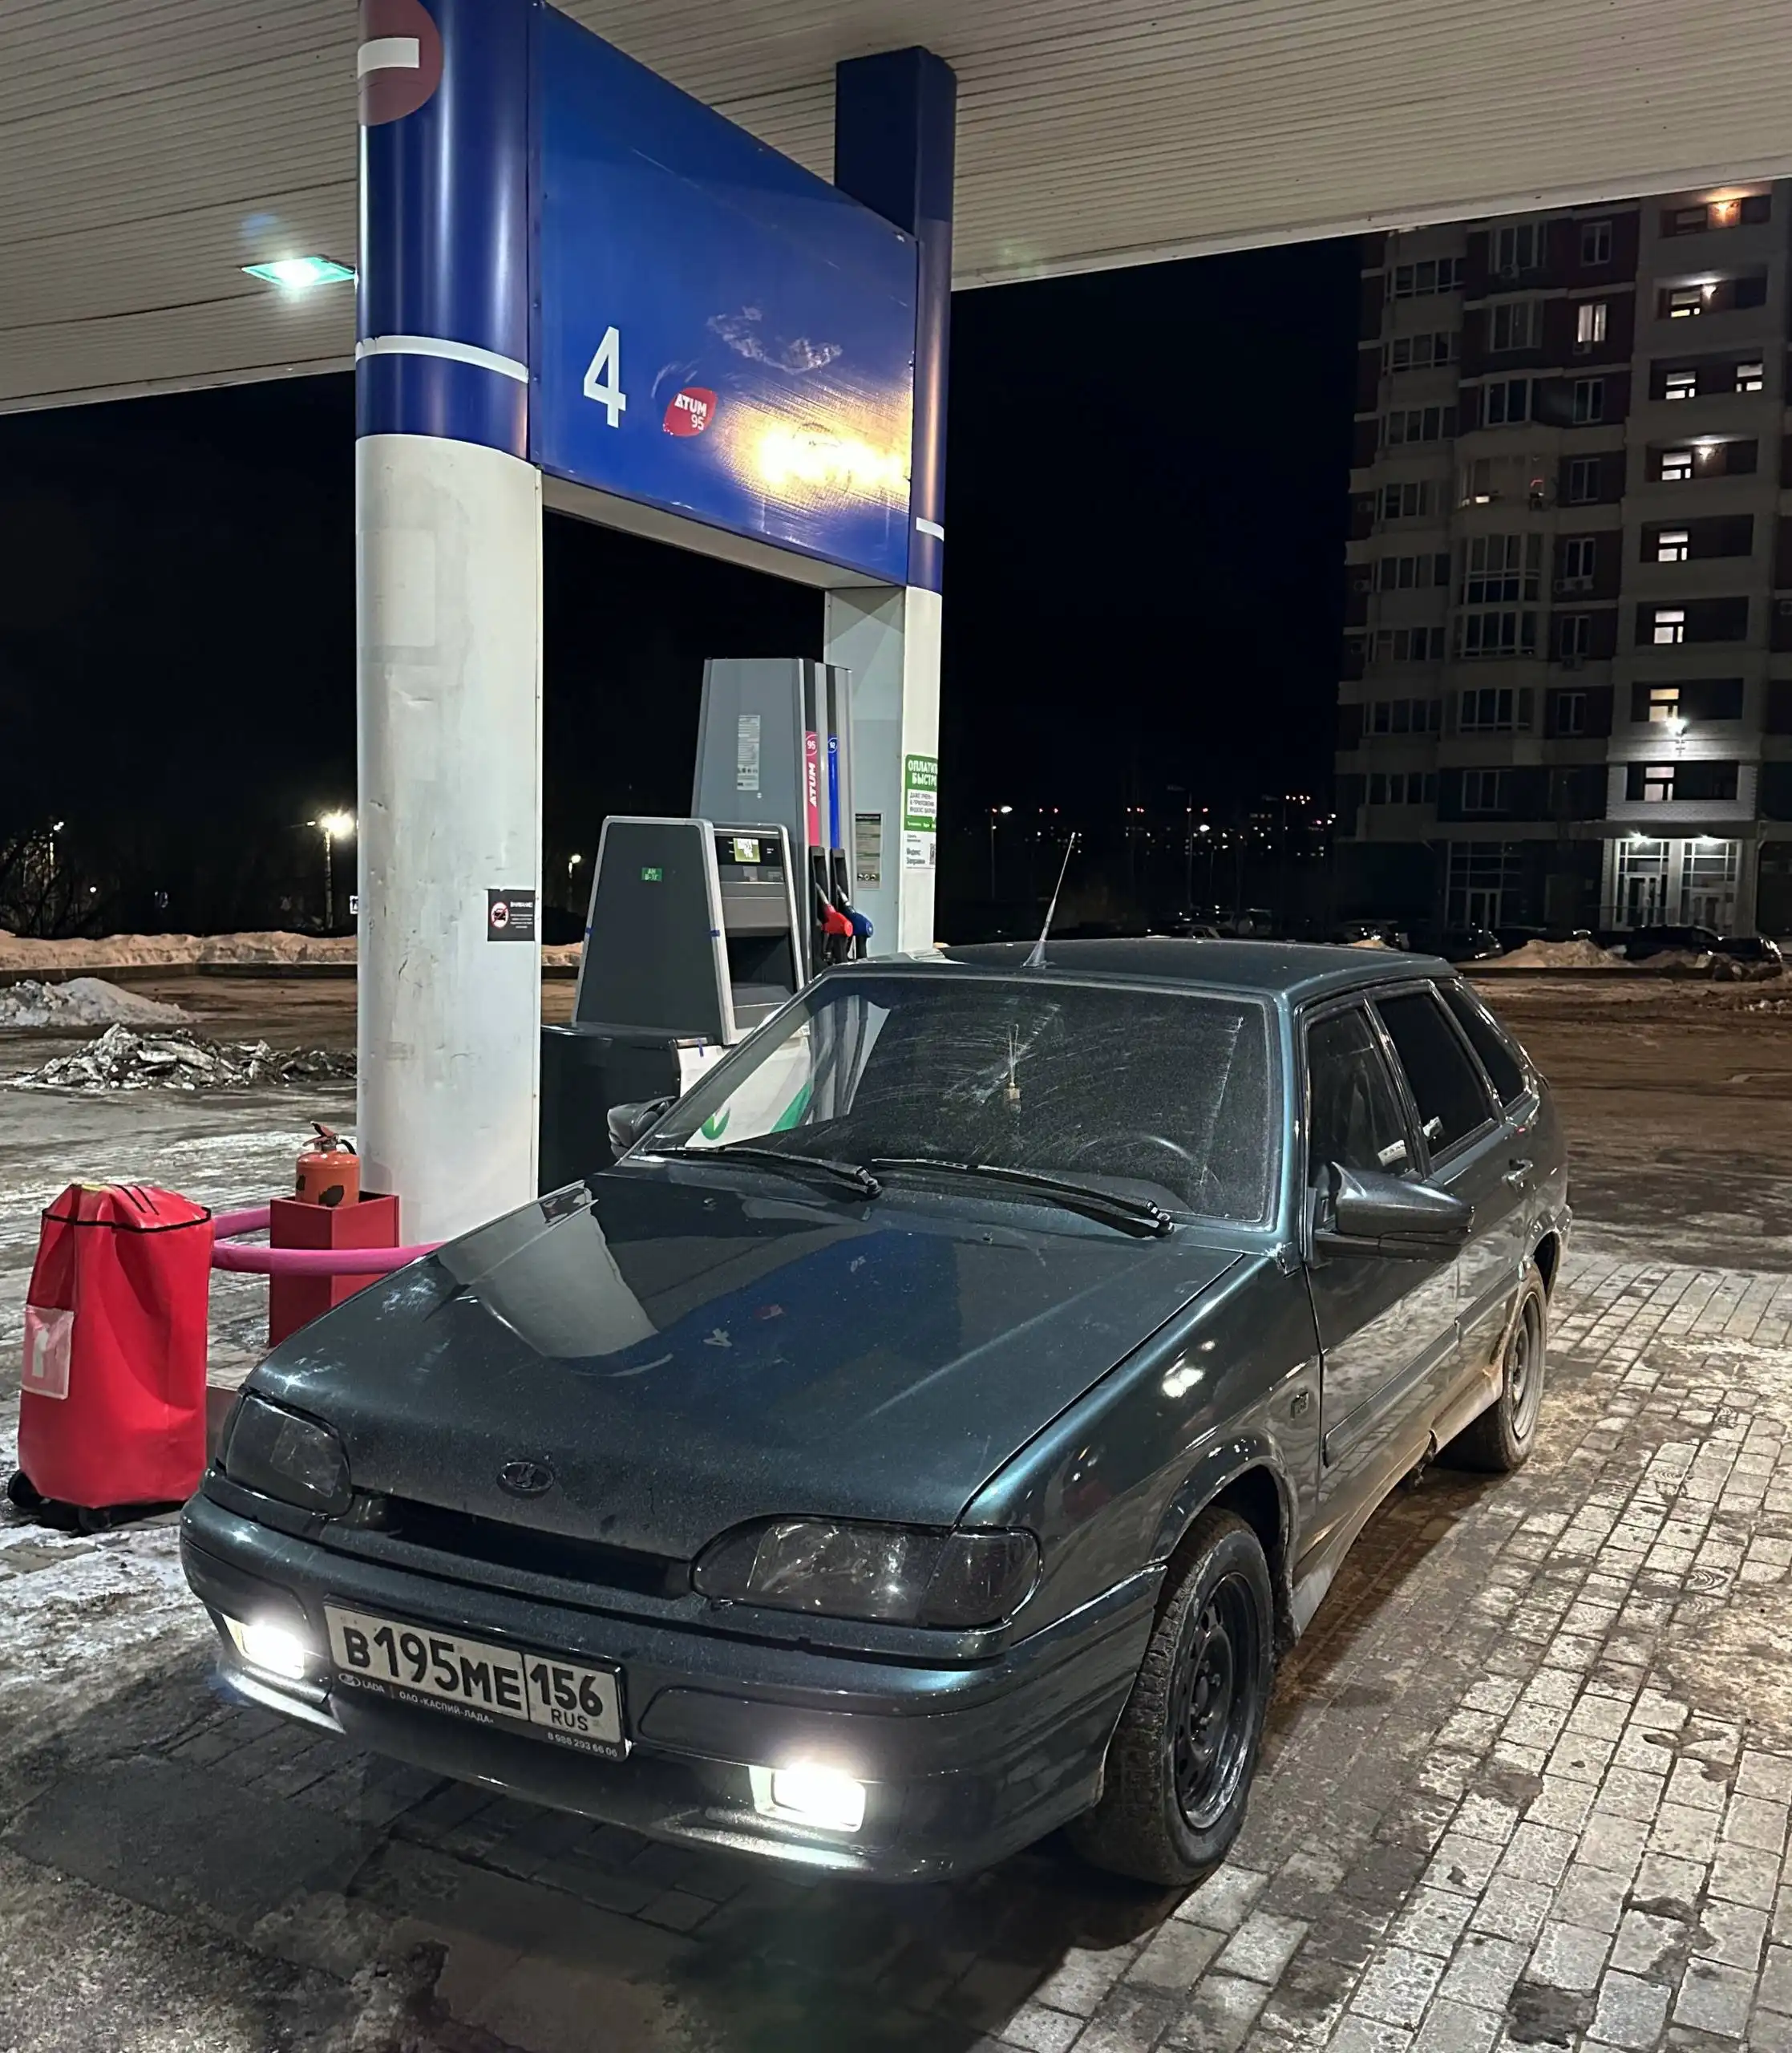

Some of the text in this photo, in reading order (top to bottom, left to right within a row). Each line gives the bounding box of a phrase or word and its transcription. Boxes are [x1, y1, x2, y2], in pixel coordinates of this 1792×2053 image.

[584, 326, 626, 428] 4
[674, 393, 707, 416] ATUM
[691, 415, 704, 431] 95
[807, 740, 815, 750] 95
[808, 762, 817, 808] ATUM
[362, 1681, 386, 1693] LADA
[399, 1691, 419, 1703] ОАО
[530, 1663, 603, 1717] 156
[551, 1709, 589, 1731] RUS
